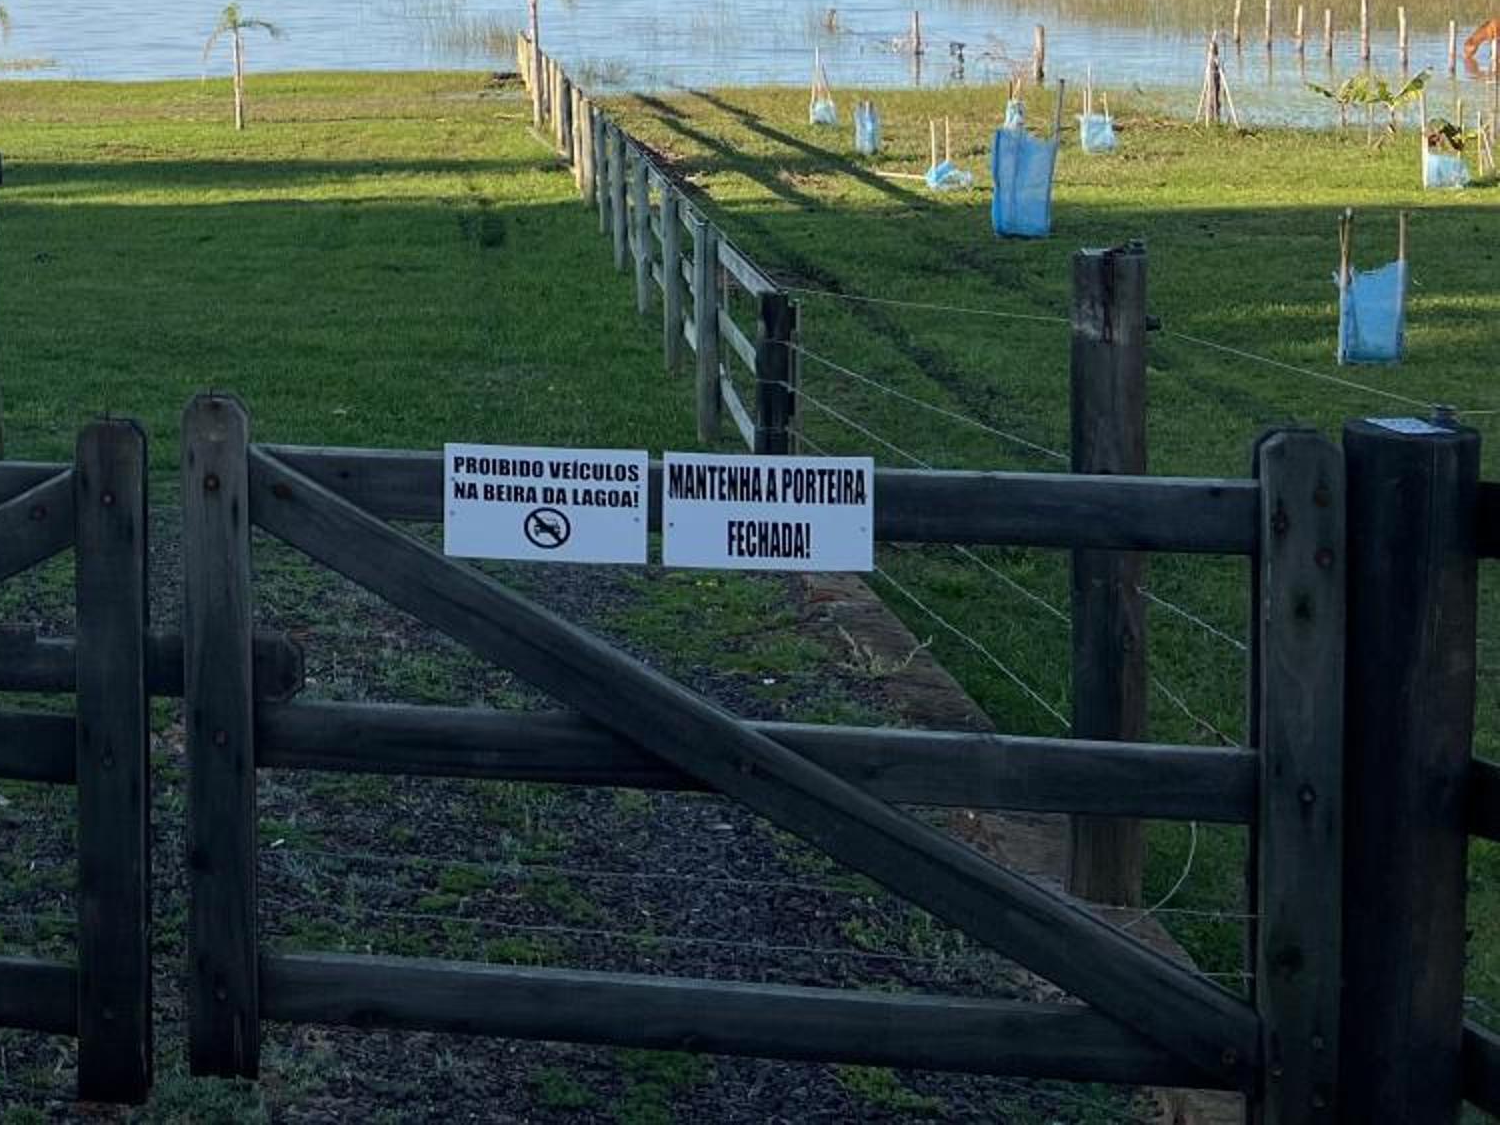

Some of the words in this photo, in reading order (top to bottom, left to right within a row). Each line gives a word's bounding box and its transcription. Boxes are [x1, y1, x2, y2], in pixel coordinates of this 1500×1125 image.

[453, 456, 543, 478] PROIBIDO
[549, 459, 639, 482] VEÍCULOS
[669, 463, 761, 502] MANTENHA
[765, 467, 778, 503] A
[781, 467, 866, 505] PORTEIRA
[453, 482, 479, 502] NA
[484, 483, 538, 504] BEIRA
[542, 485, 568, 506] DA
[572, 487, 639, 508] LAGOA!
[727, 520, 811, 559] FECHADA!
